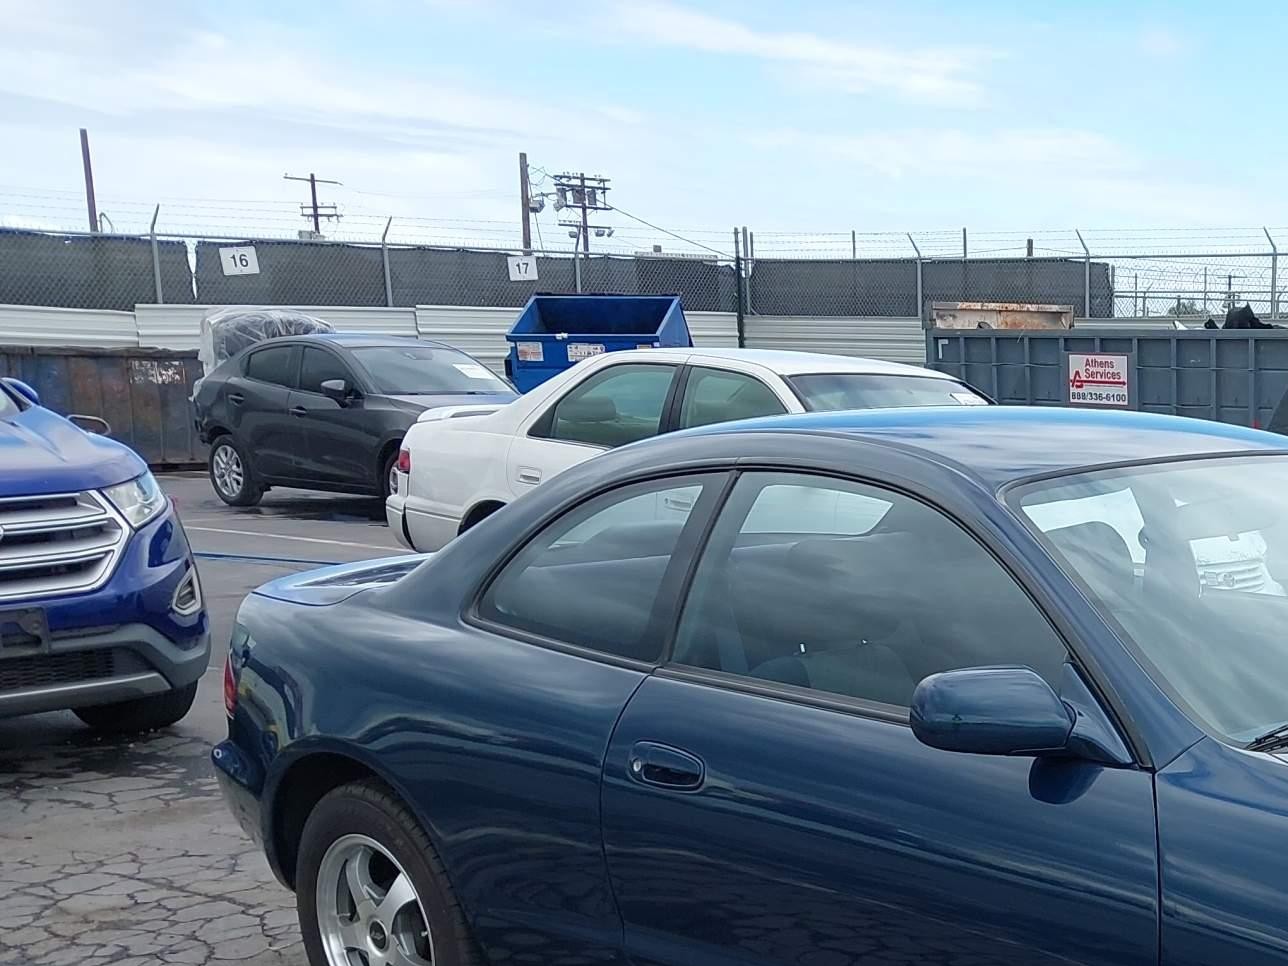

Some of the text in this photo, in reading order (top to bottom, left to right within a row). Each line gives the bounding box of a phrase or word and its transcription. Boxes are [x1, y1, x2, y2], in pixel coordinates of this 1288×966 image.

[229, 253, 249, 268] 16
[515, 261, 529, 275] 17
[1085, 358, 1115, 368] Athens
[1085, 368, 1122, 380] Services
[1071, 392, 1127, 402] 888/336-6100
